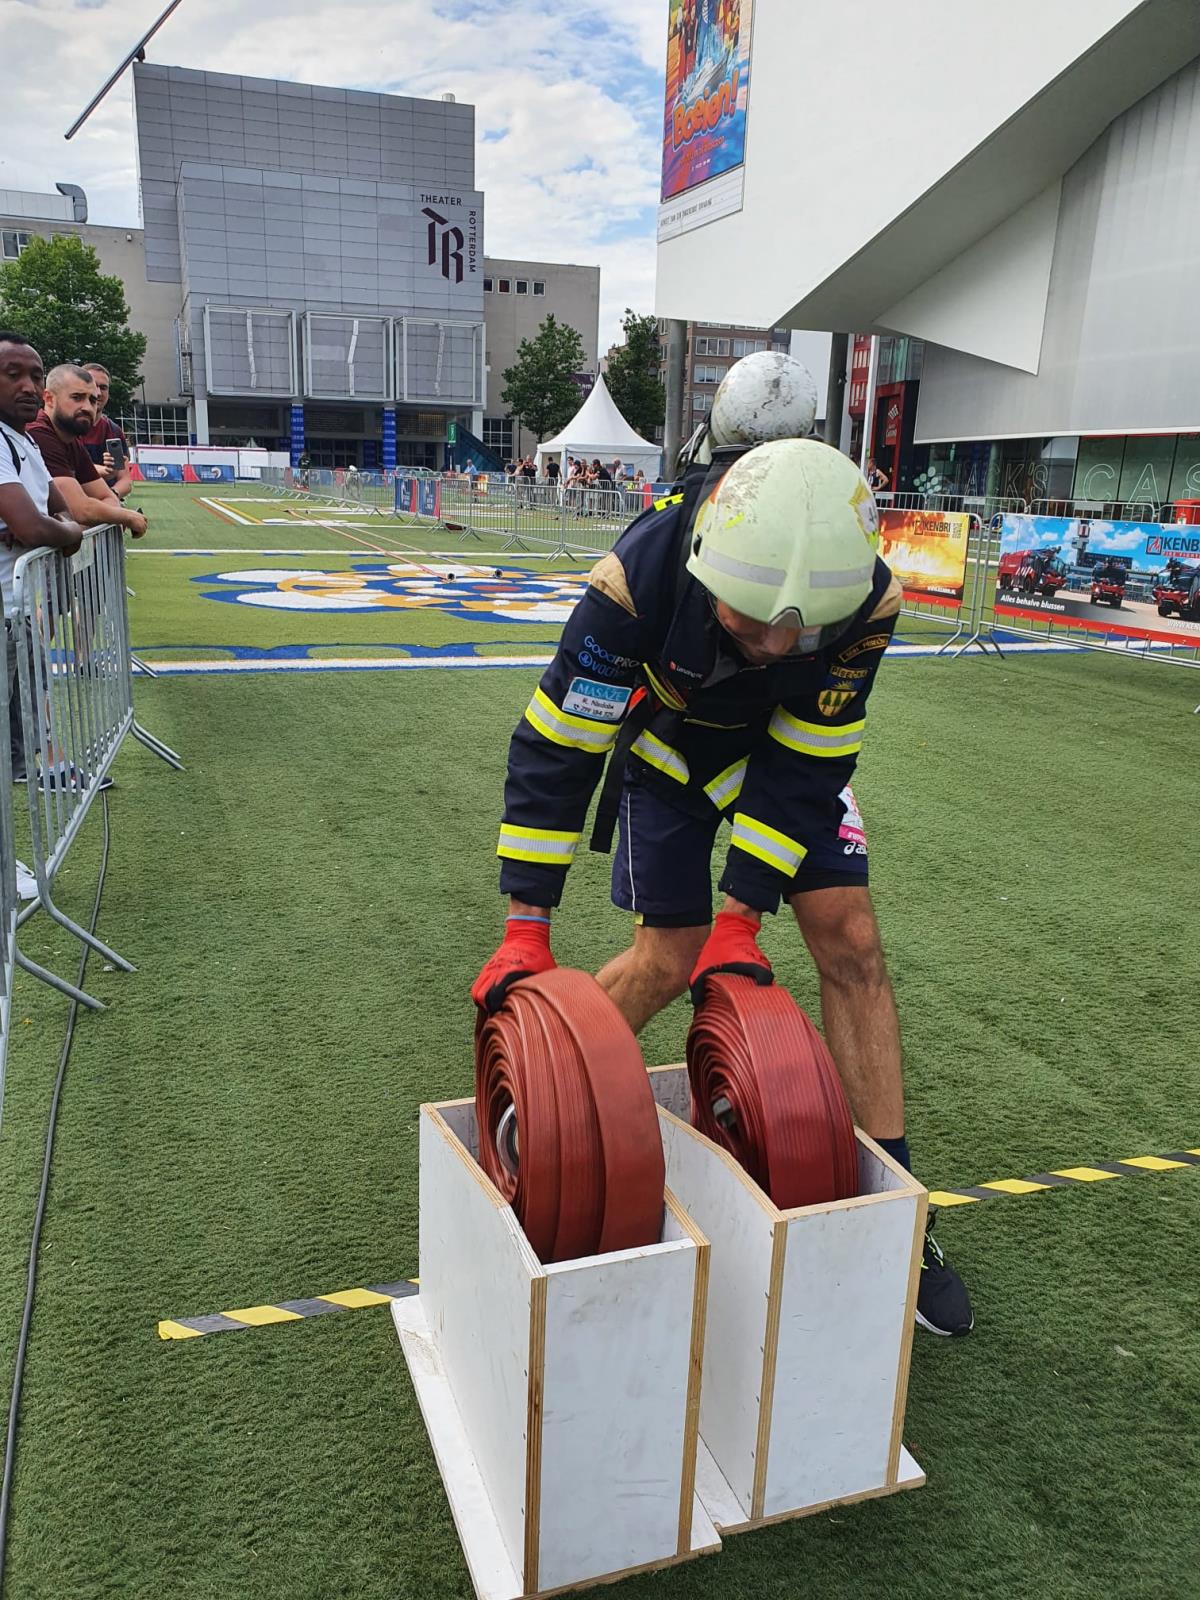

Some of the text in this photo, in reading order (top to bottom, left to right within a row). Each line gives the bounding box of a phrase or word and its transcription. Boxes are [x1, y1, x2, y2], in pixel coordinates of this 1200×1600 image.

[673, 68, 739, 147] Boeien!
[420, 194, 462, 206] THEATER
[469, 210, 477, 273] ROTTERDAM
[923, 521, 951, 533] KENBRI
[1001, 595, 1065, 611] Alles behalve blussen
